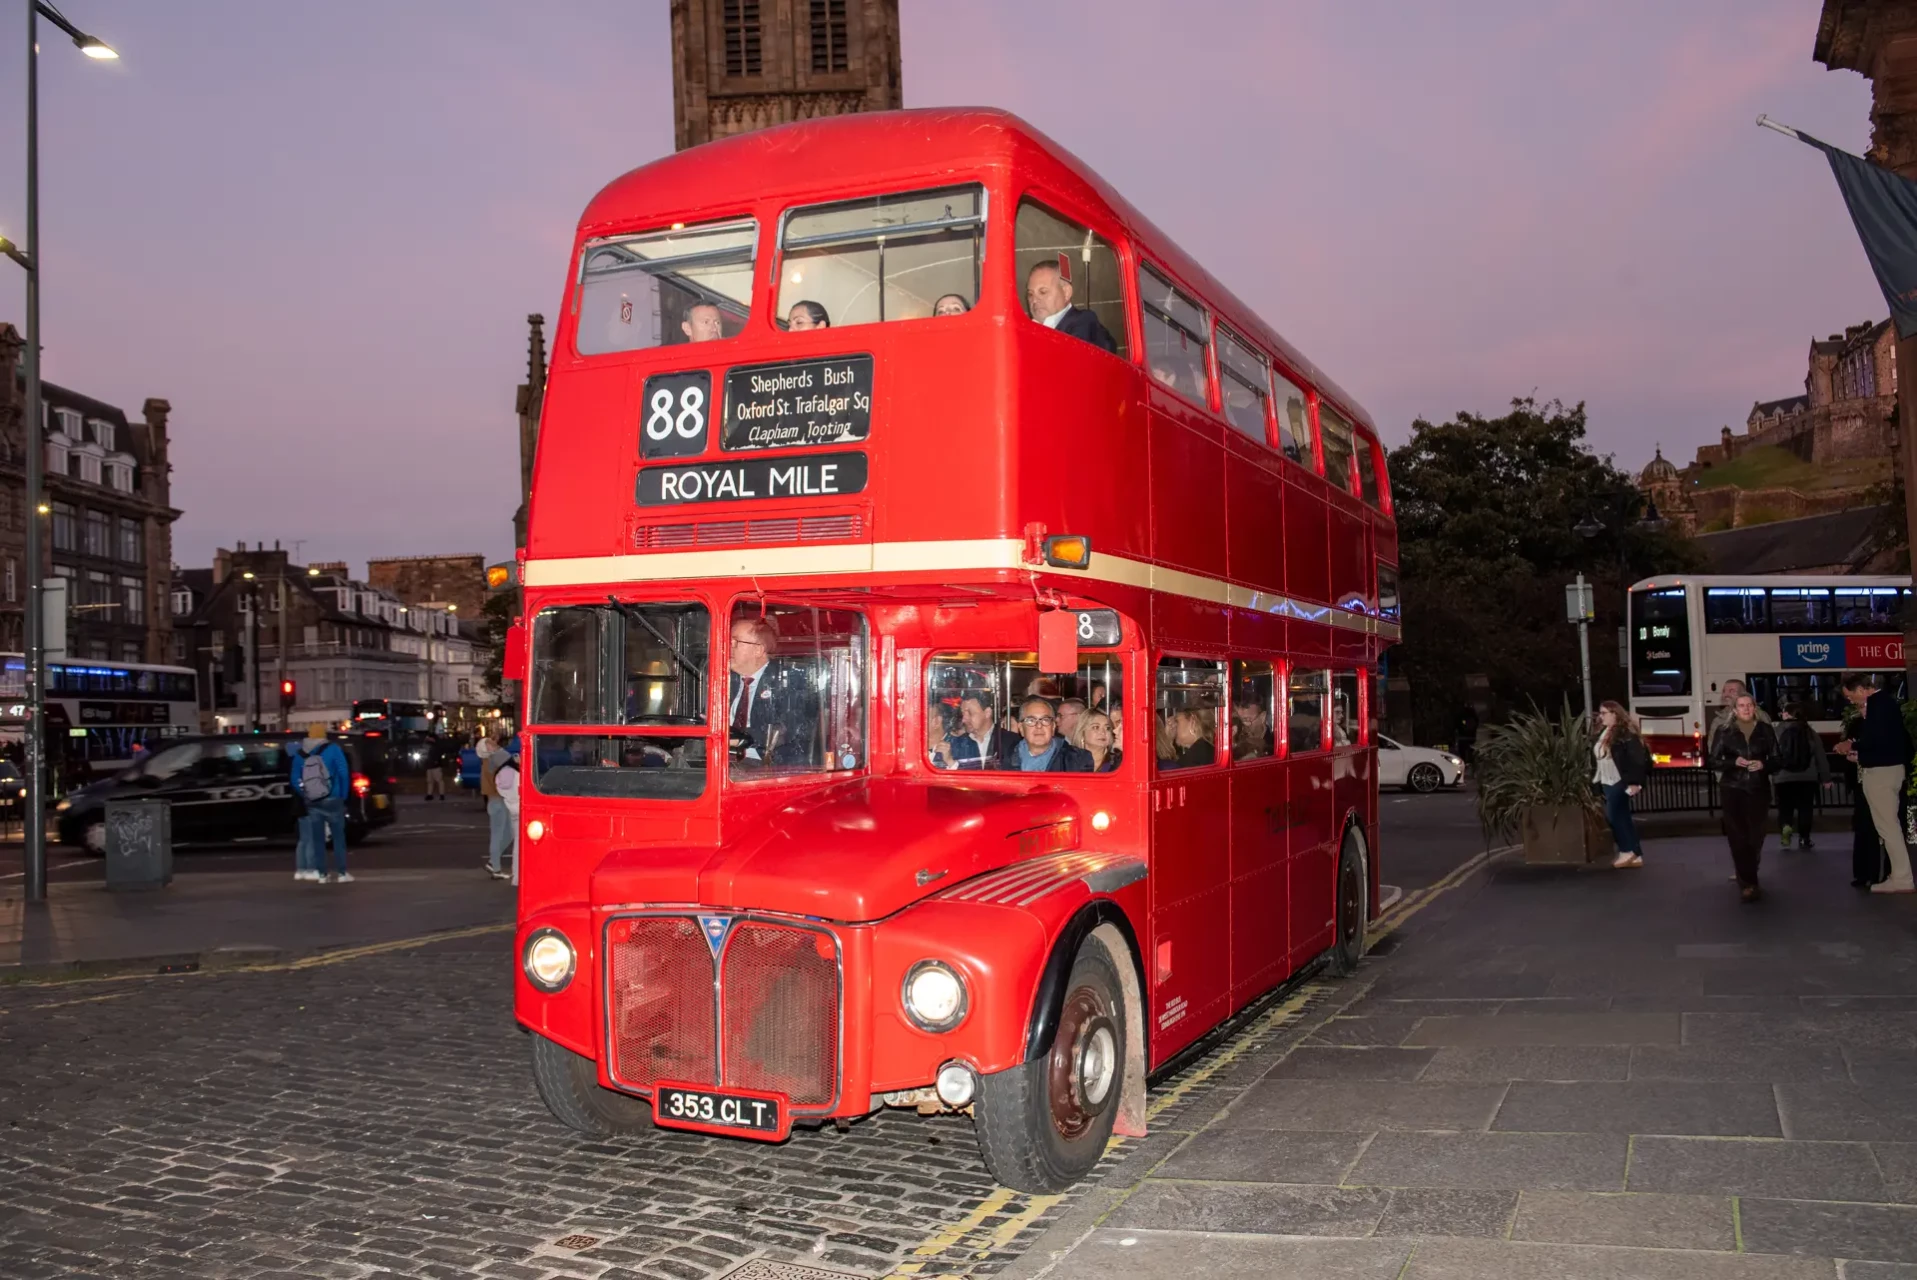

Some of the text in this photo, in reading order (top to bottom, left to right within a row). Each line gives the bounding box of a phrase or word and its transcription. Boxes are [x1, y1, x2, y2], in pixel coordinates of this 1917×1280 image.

[751, 366, 854, 395] Shepherds Bush
[646, 386, 704, 440] 88
[737, 391, 870, 420] Oxford St. Trafalgar Sq
[748, 420, 852, 443] Clapham Tooting
[661, 464, 839, 500] ROYAL MILE
[1797, 642, 1830, 655] prime
[1858, 645, 1881, 657] THE
[9, 704, 26, 716] 47
[670, 1093, 767, 1126] 353 CLT
